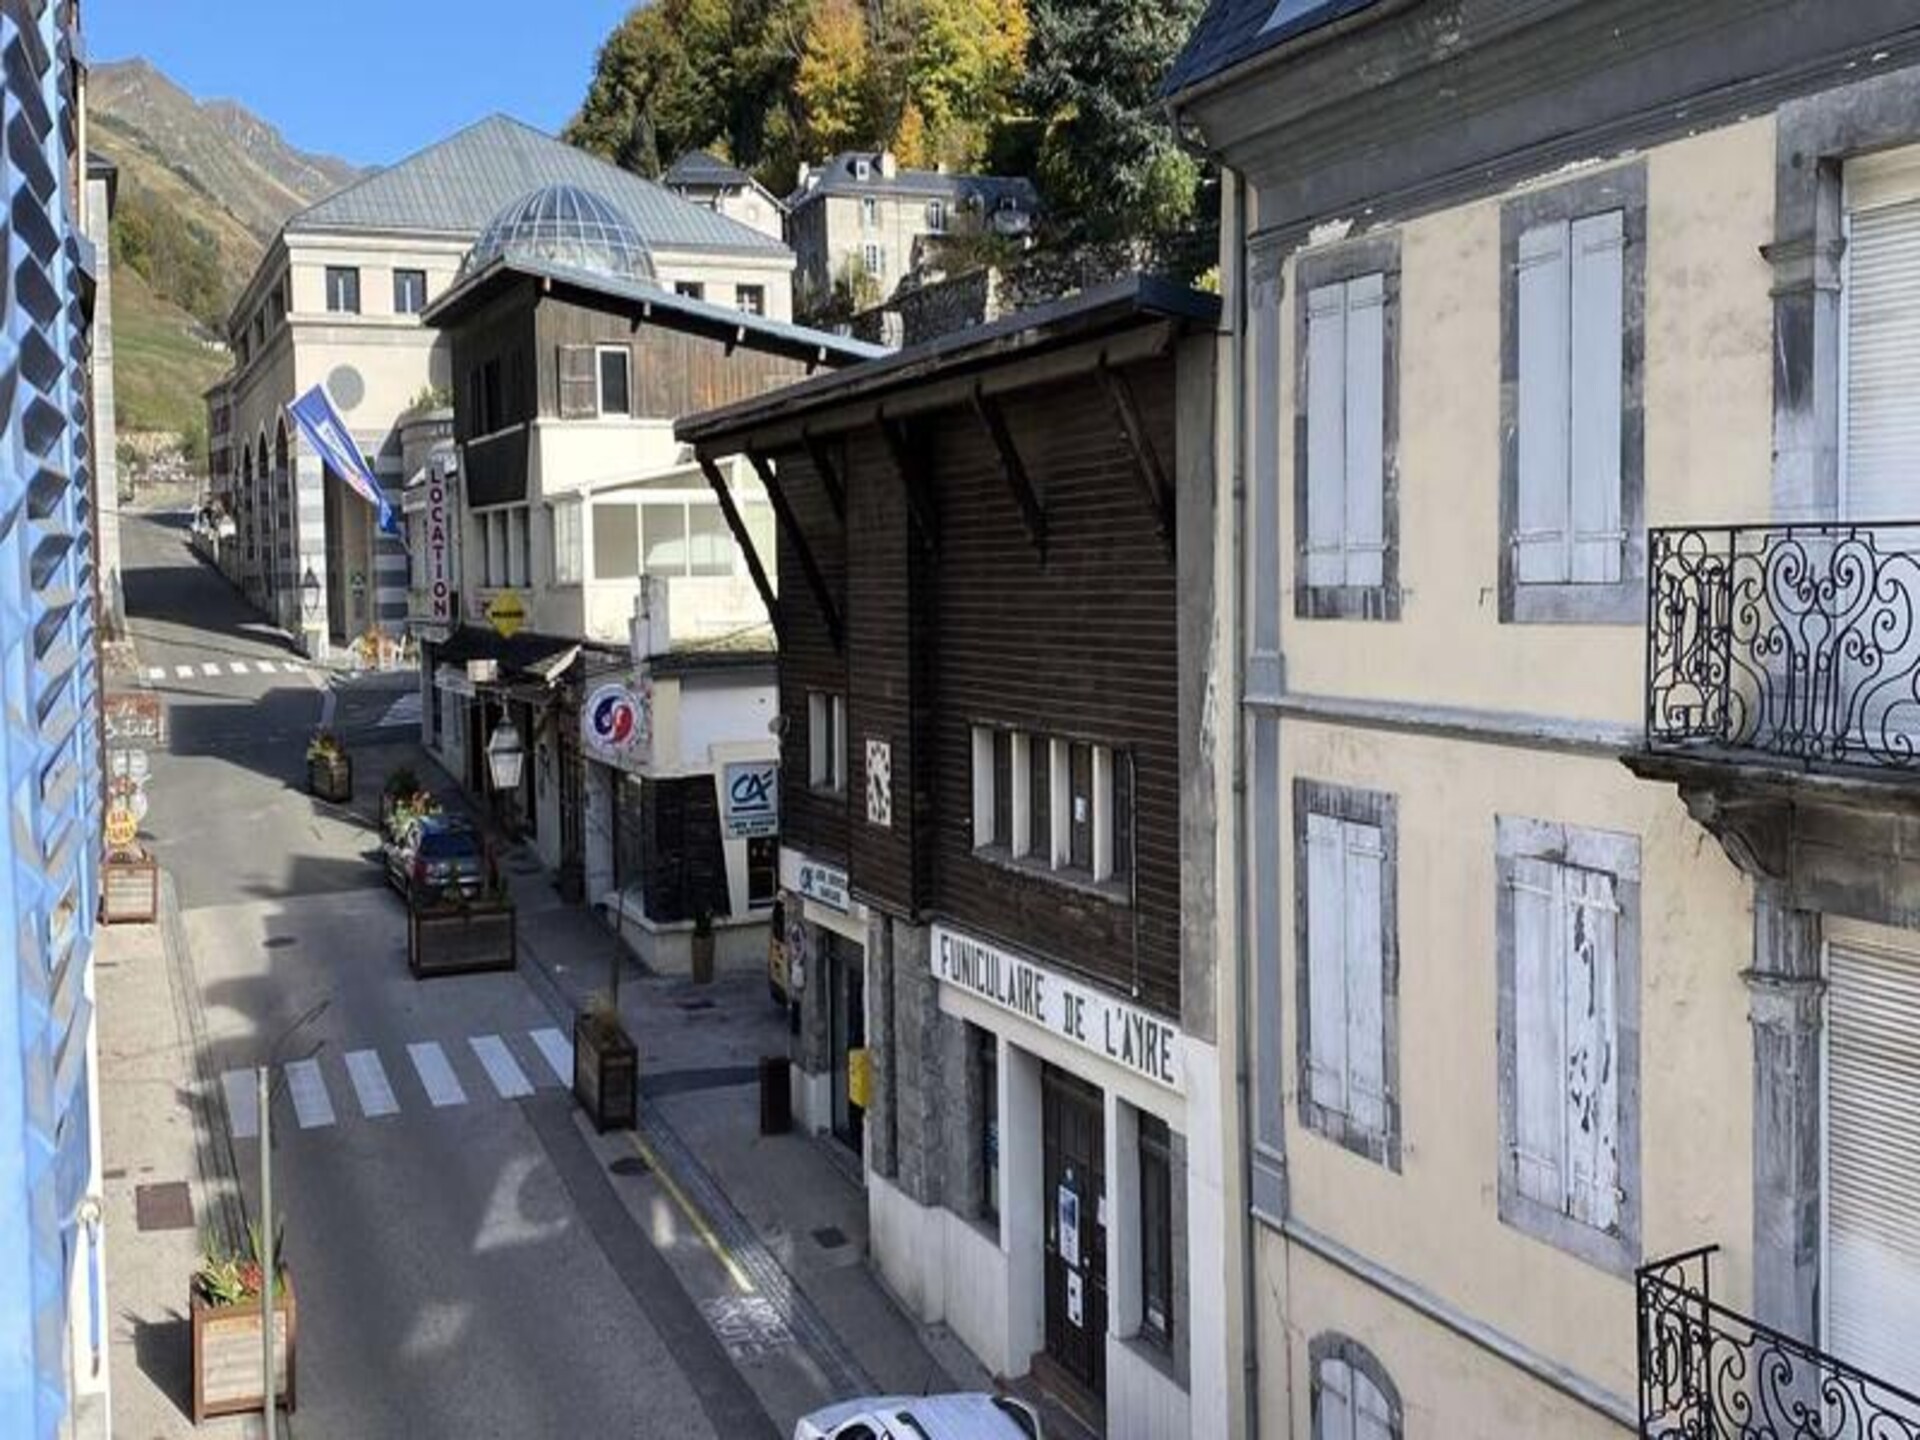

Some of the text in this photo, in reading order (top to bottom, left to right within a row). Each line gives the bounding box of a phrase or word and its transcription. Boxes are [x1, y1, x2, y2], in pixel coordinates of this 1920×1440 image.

[430, 467, 447, 617] LOCATION
[940, 935, 1175, 1085] FUNICULAIRE DE L'AYRE
